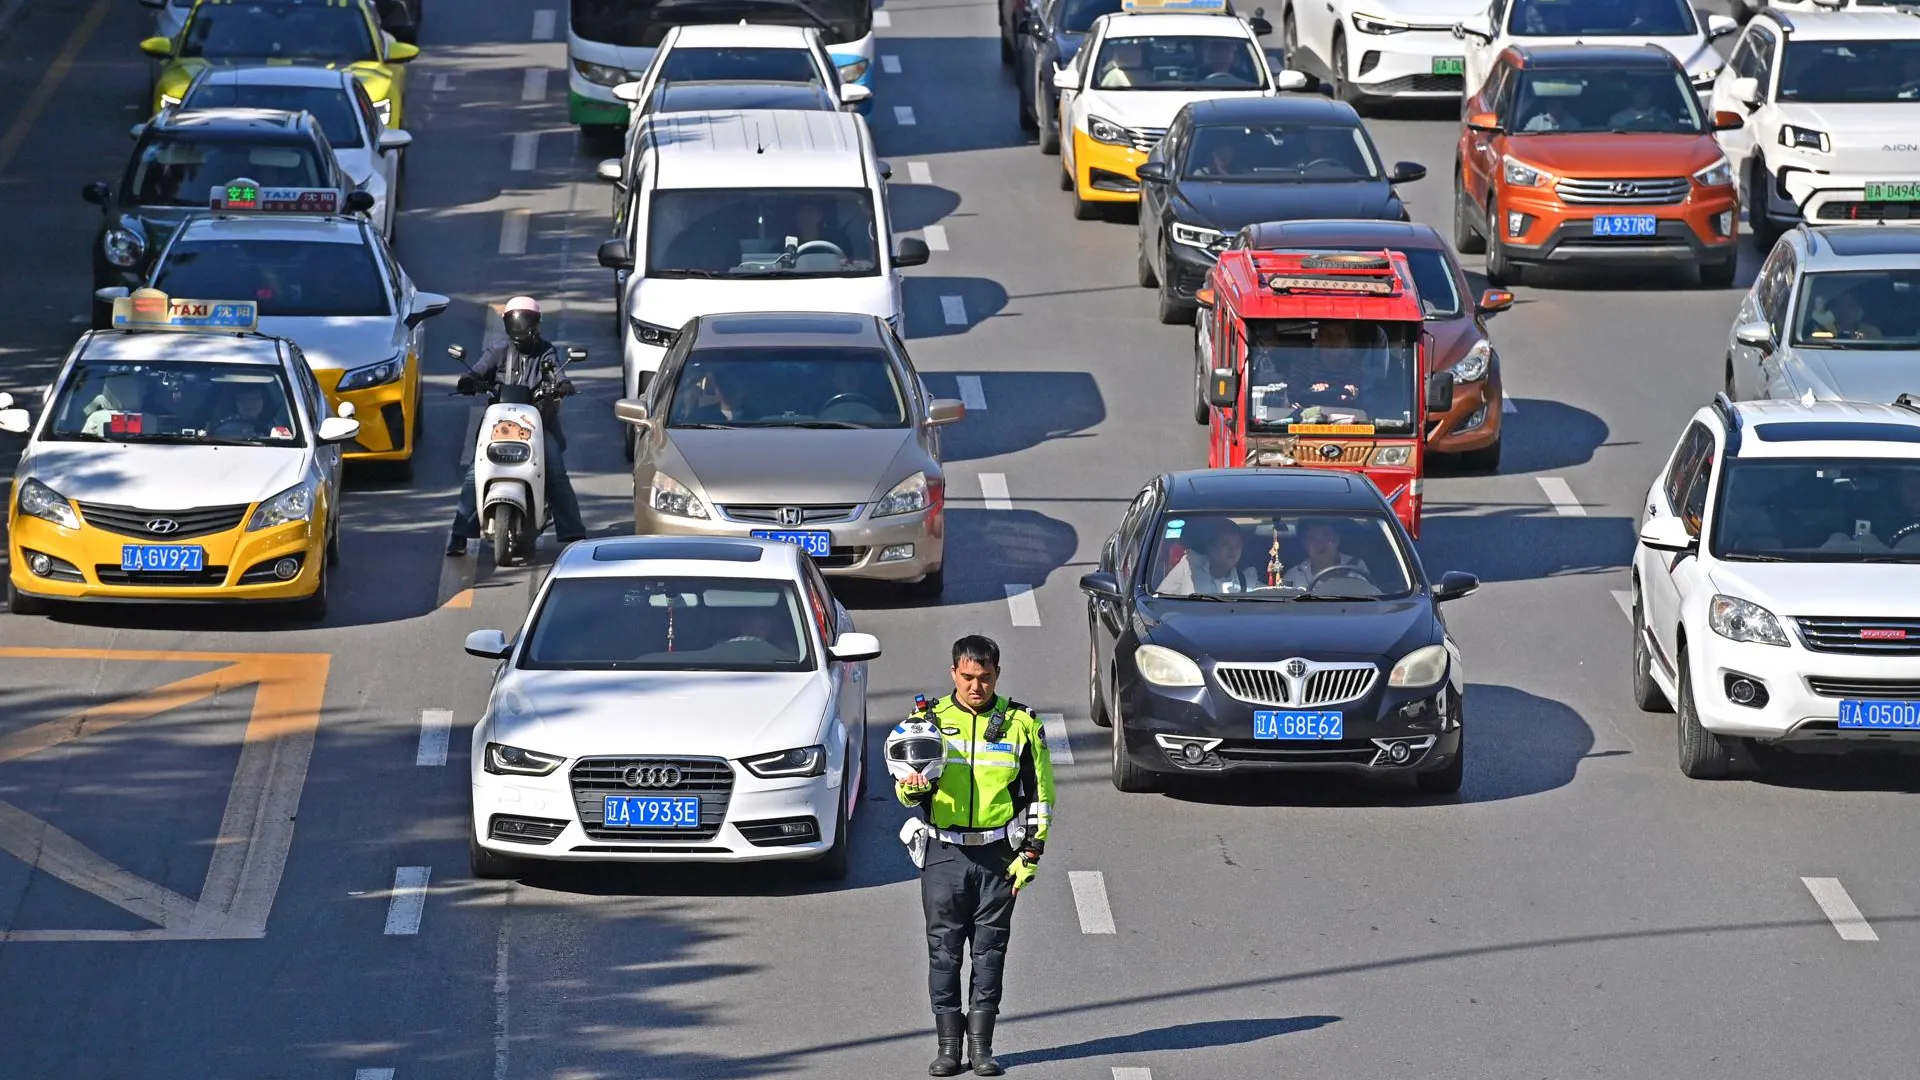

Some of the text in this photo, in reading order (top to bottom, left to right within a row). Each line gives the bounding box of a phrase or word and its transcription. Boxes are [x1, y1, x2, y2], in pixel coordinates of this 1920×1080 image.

[227, 186, 256, 201] 空车
[264, 191, 334, 201] TAXI 沈阳
[172, 304, 208, 316] TAXI
[217, 306, 251, 318] 沈阳
[123, 549, 200, 567] 辽A·GV927
[1256, 715, 1340, 735] 辽A·G8E62
[607, 801, 695, 822] 辽A·Y933E
